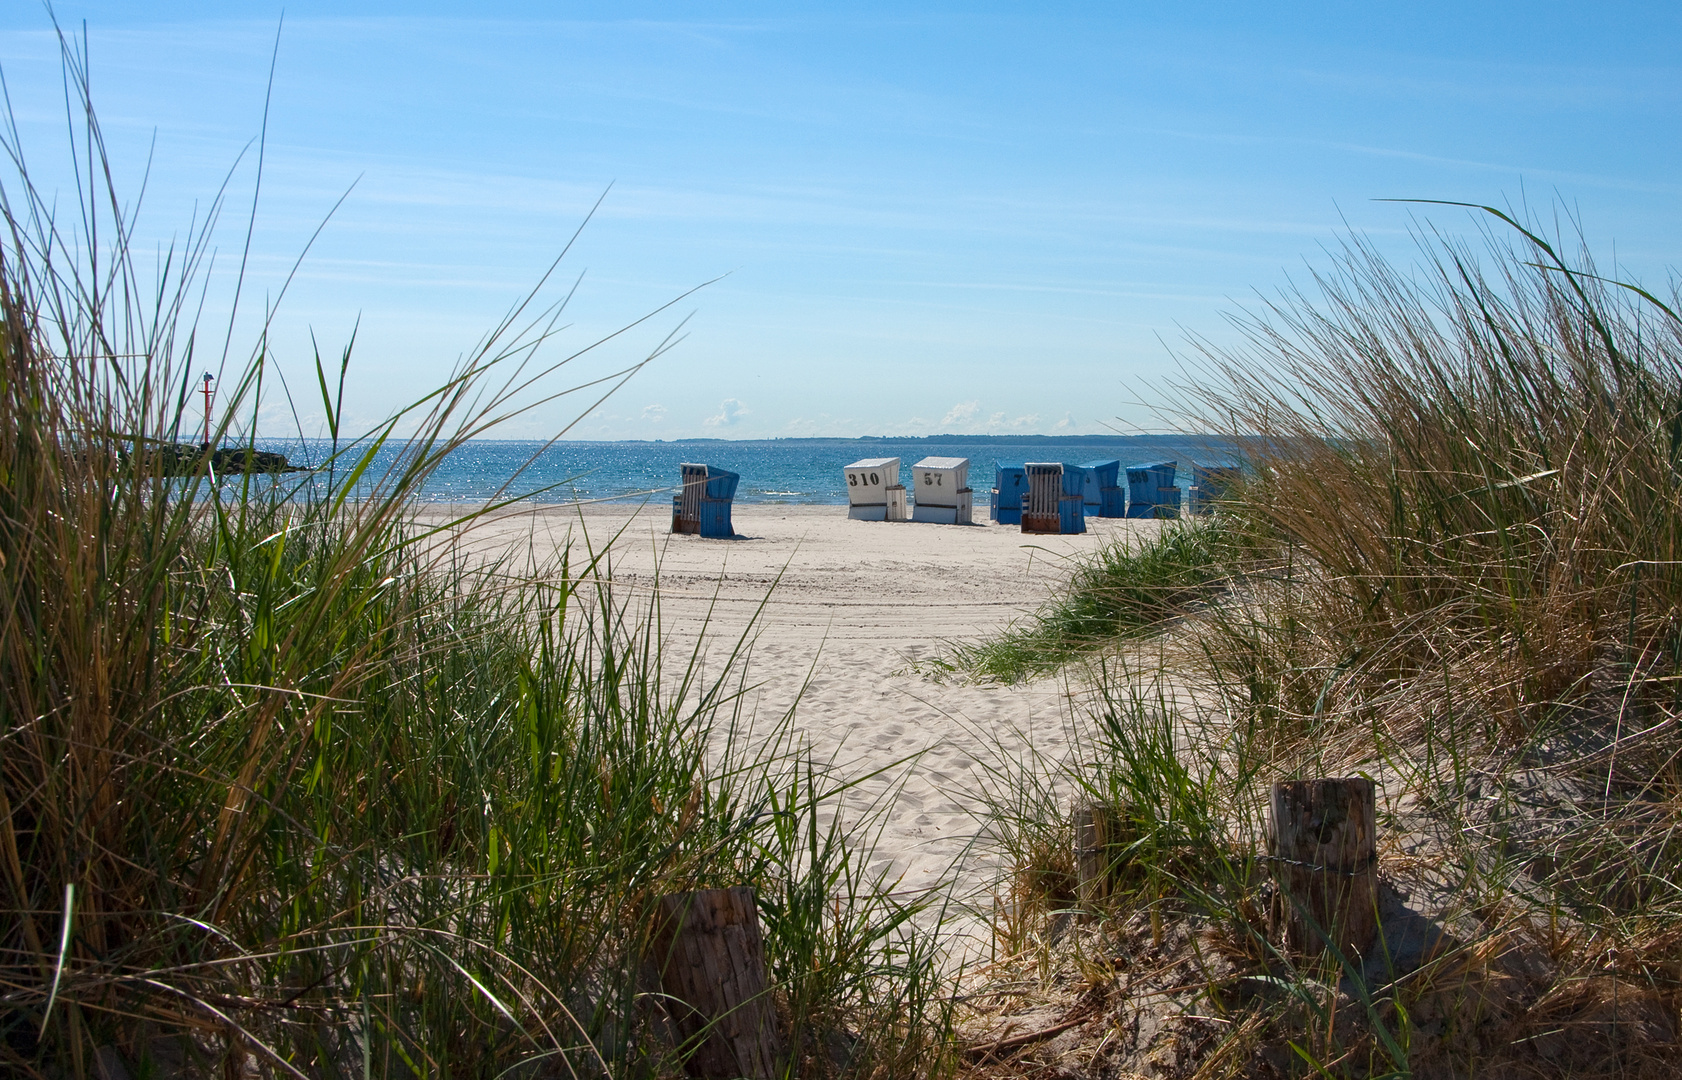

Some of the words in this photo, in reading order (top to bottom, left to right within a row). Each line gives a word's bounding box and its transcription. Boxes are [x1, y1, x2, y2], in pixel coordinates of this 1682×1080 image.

[848, 472, 880, 487] 310
[924, 472, 943, 487] 57
[1013, 474, 1023, 487] 7
